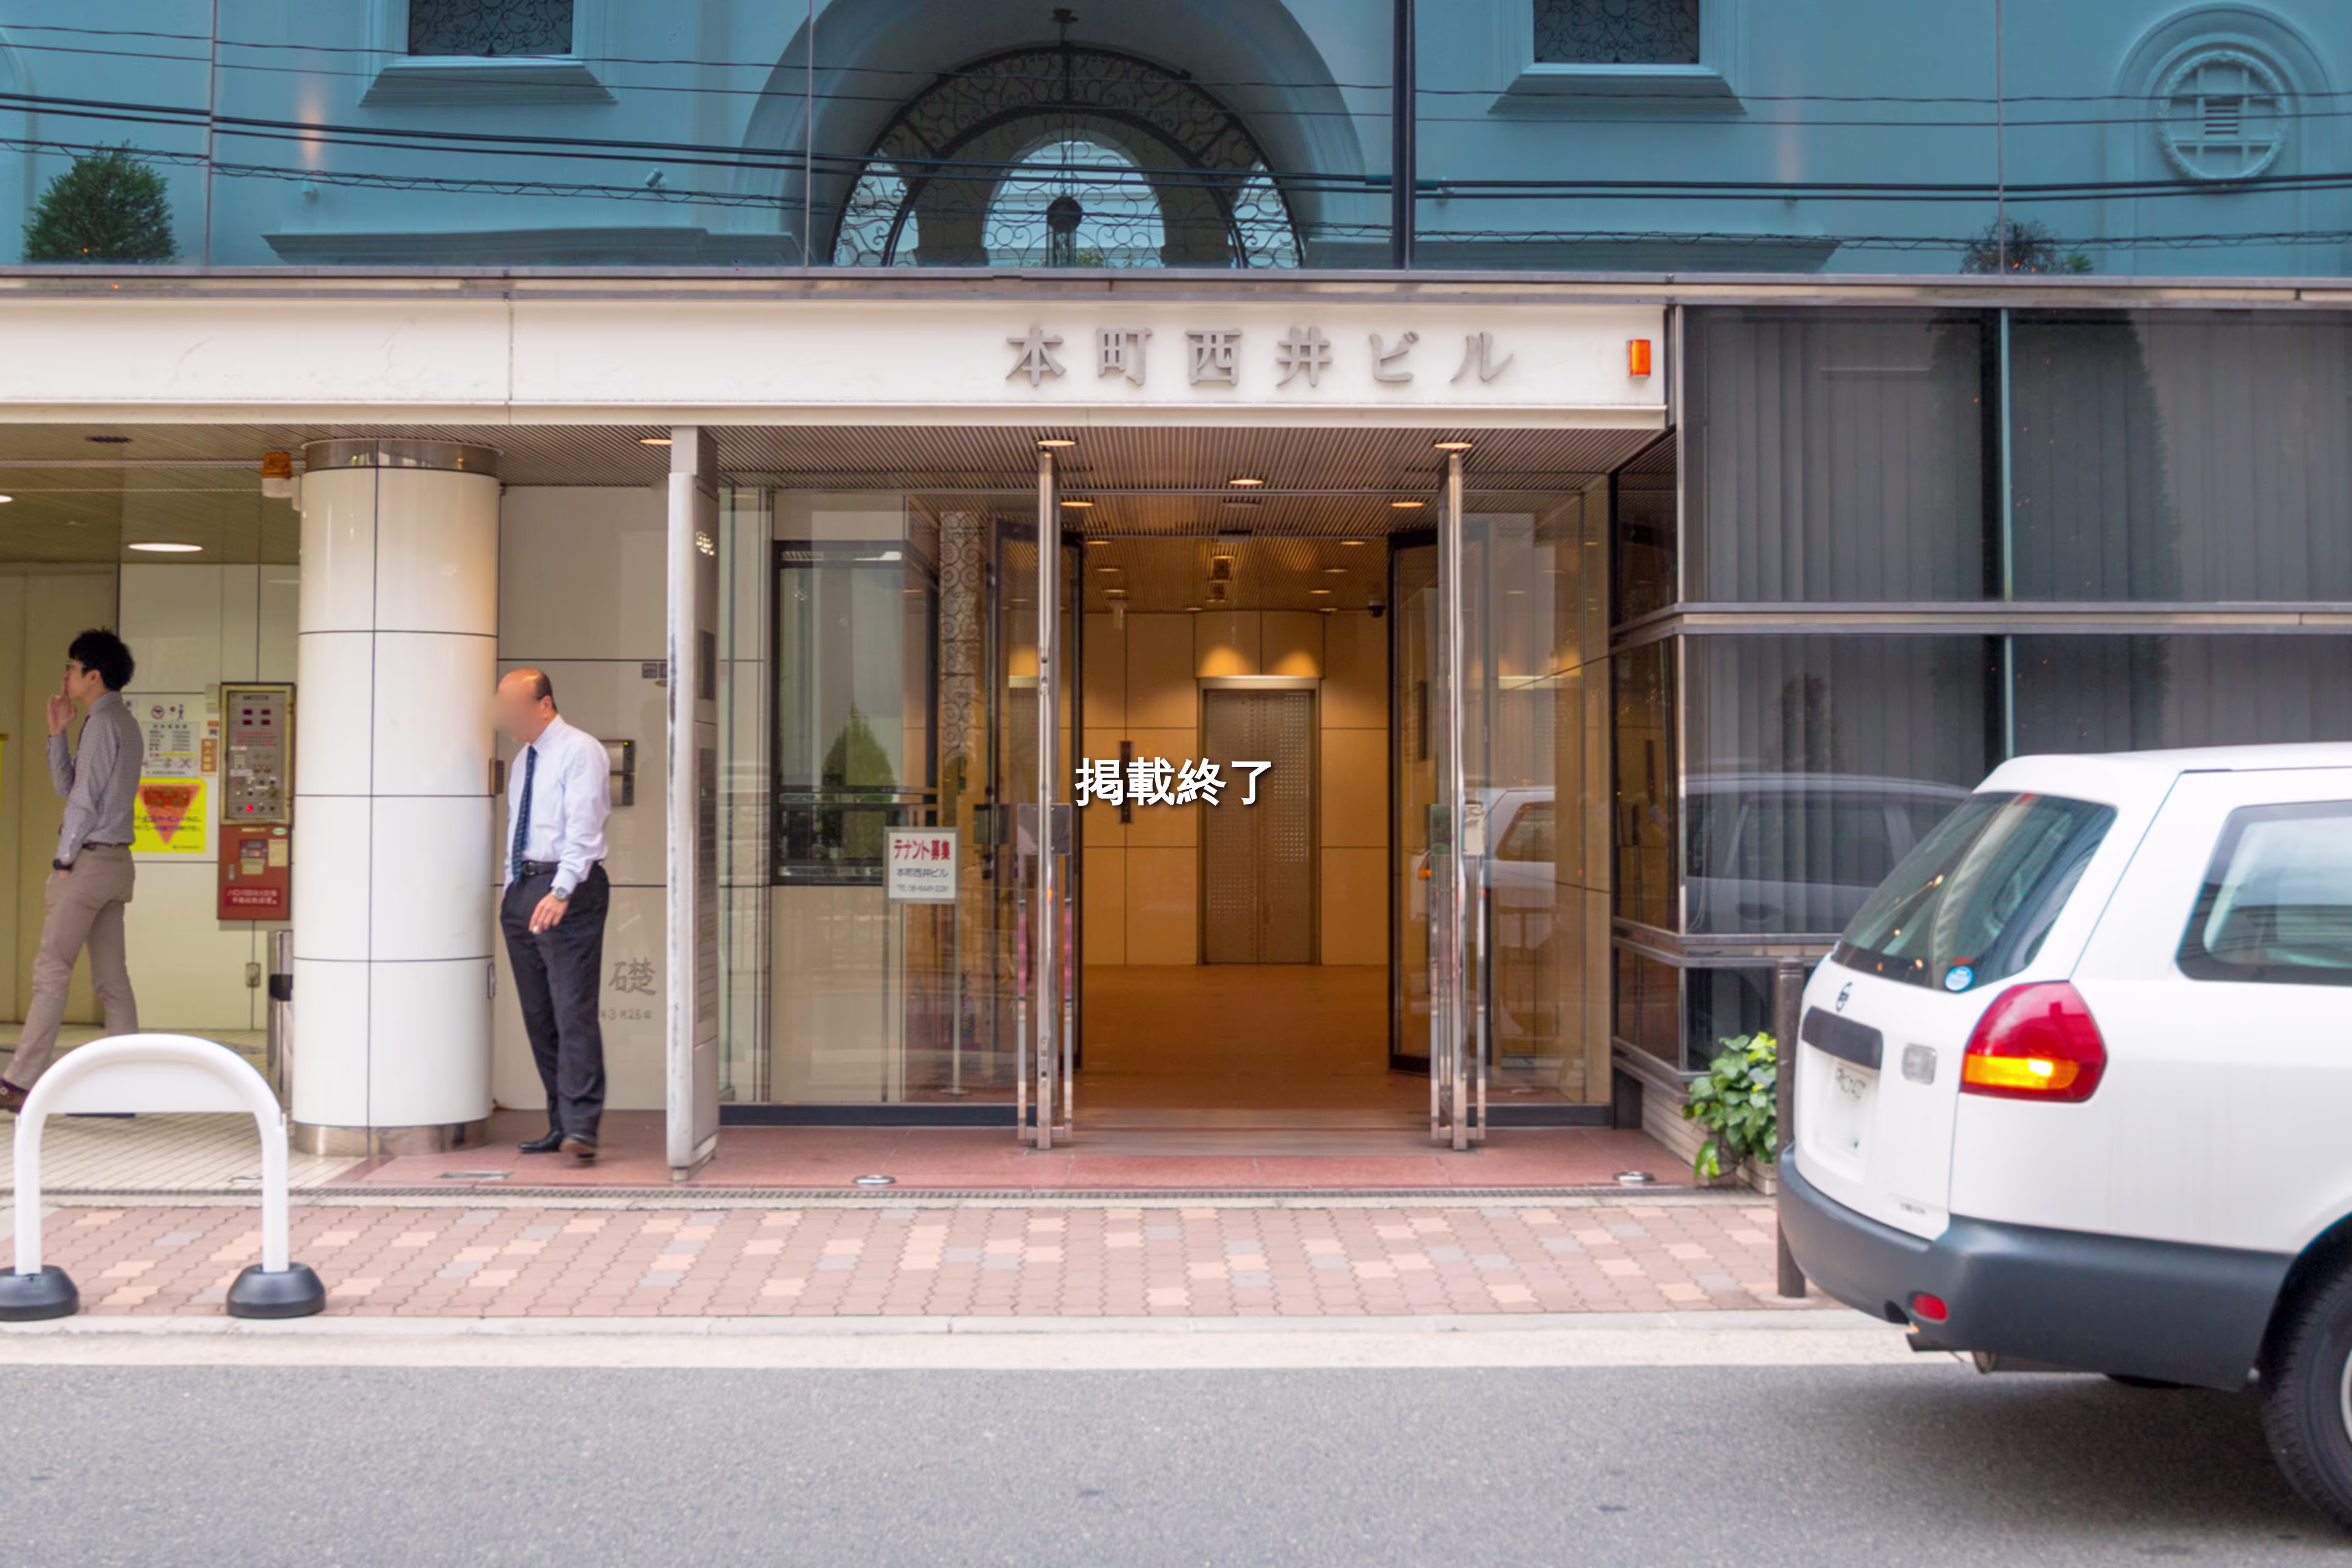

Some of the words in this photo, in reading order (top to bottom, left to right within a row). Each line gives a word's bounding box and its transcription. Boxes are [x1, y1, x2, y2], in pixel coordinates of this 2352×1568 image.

[1006, 325, 1515, 387] 本町西井ビル
[894, 839, 951, 861] テナント募集
